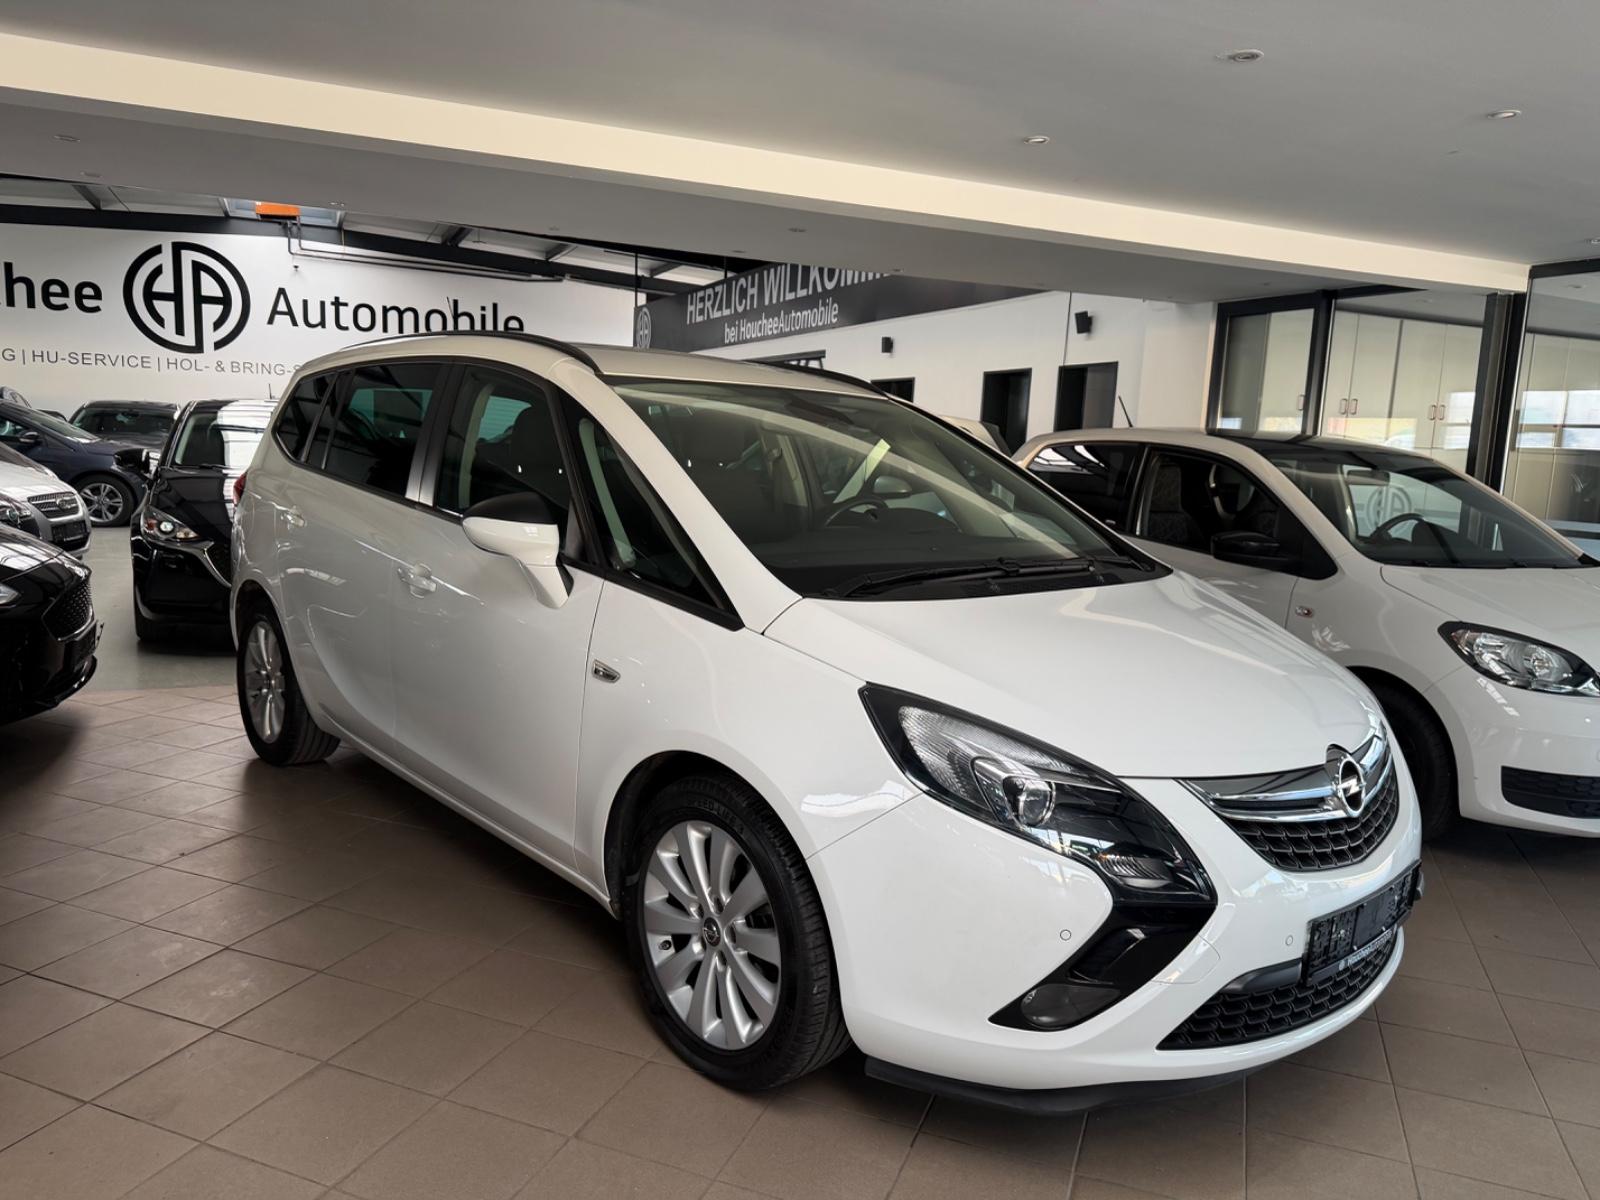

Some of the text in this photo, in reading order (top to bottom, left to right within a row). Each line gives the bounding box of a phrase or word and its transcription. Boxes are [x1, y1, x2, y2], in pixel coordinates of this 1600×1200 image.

[3, 261, 102, 313] hee
[267, 286, 525, 334] Automobile
[686, 263, 890, 325] HERZLICH WILLKO
[724, 297, 839, 344] bei HoucheeAutomobile
[32, 350, 152, 369] HU-SERVICE
[167, 358, 210, 372] HOL-
[215, 360, 226, 373] &
